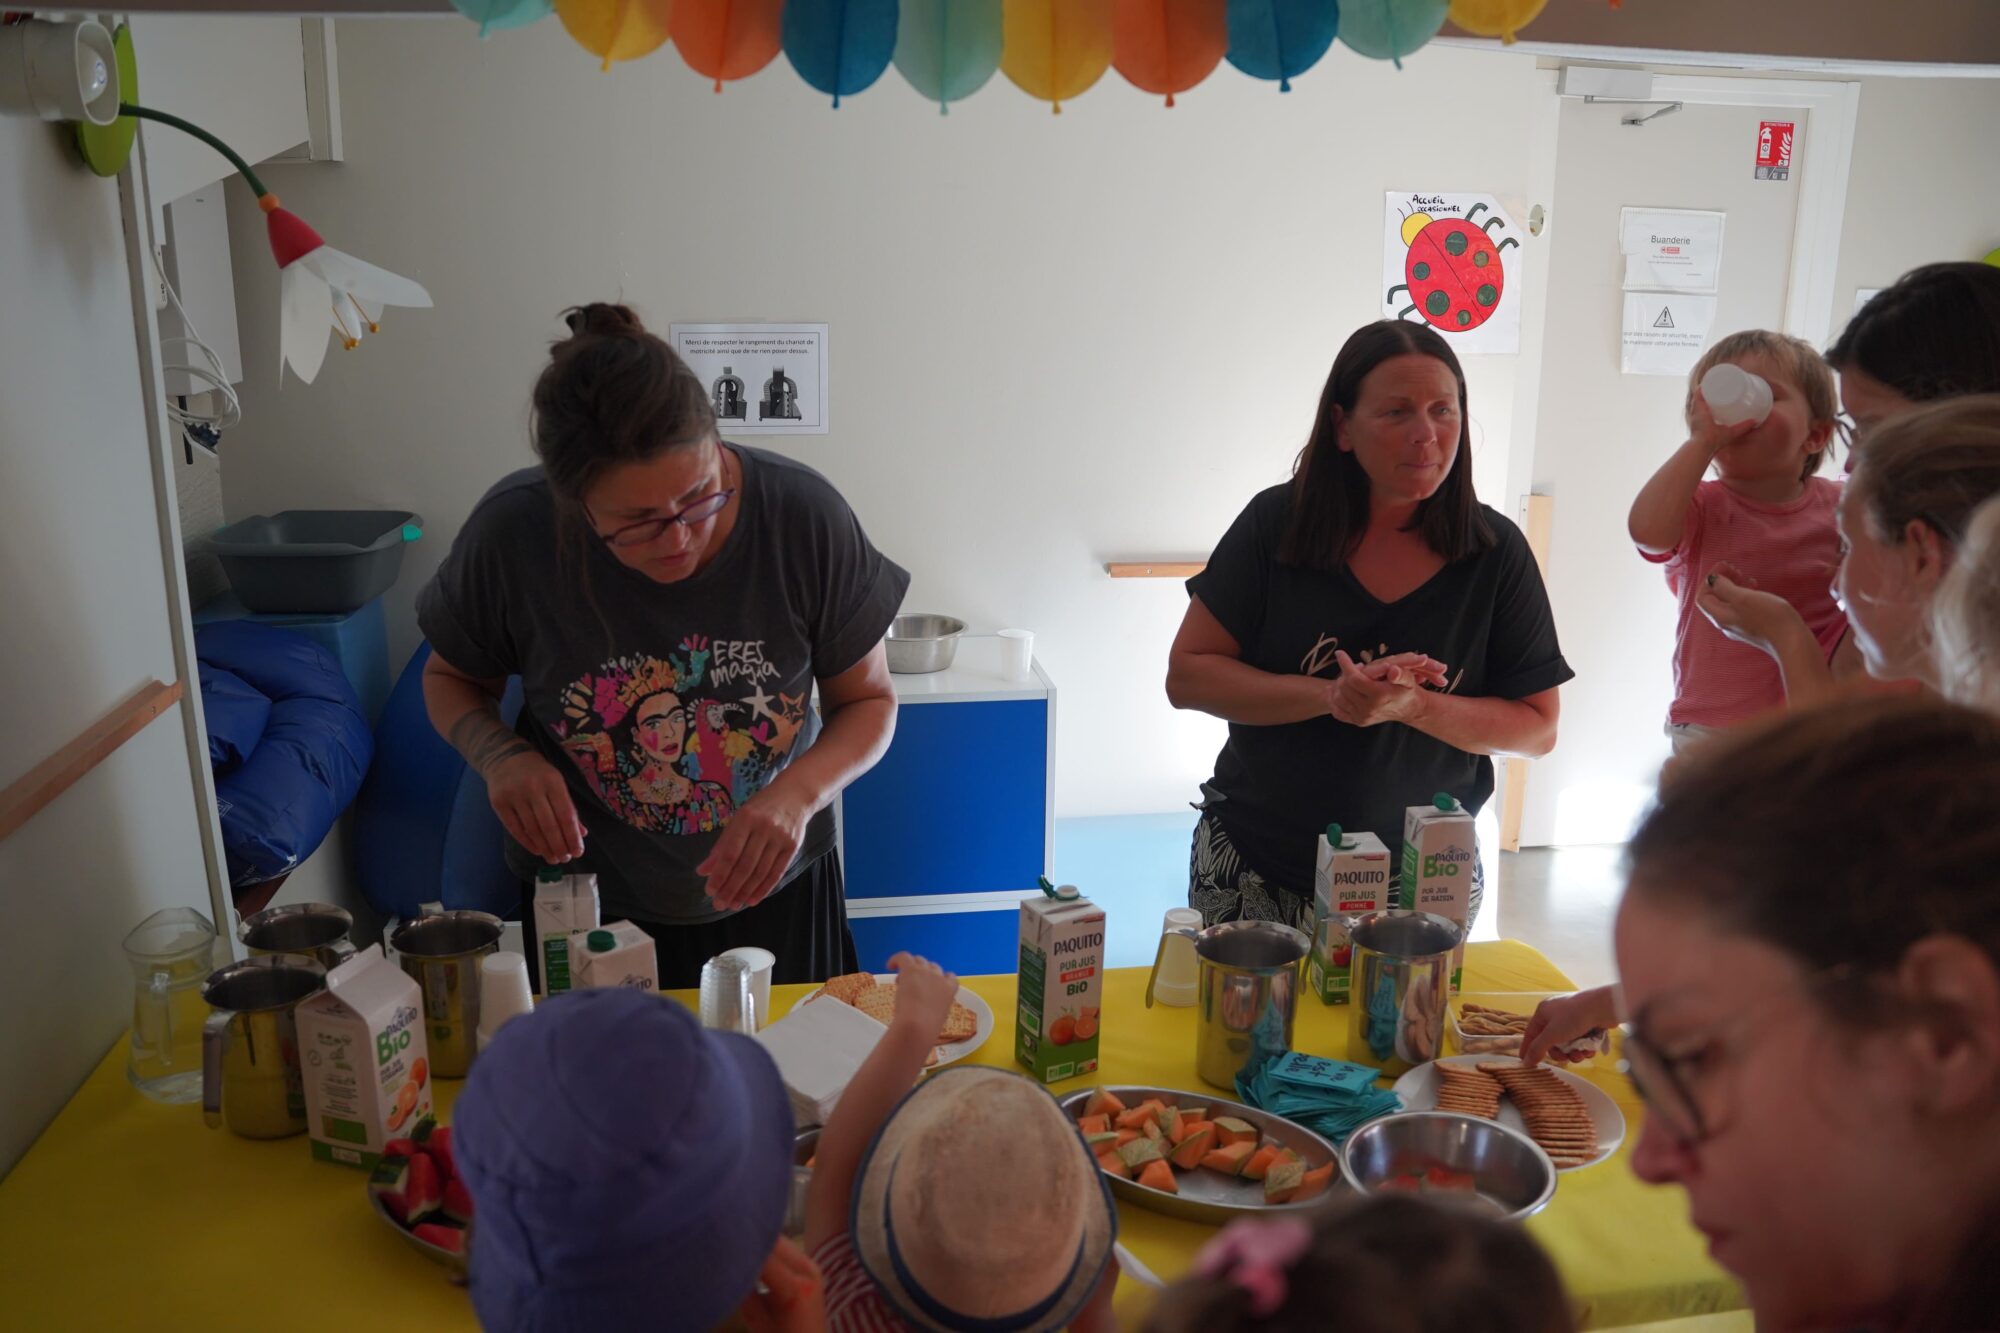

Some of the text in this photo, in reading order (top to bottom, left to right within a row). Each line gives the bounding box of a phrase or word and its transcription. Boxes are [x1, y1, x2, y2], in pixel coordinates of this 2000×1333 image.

[1650, 234, 1691, 245] Buanderie
[713, 640, 765, 666] ERES
[710, 660, 781, 687] magia
[1434, 852, 1470, 864] PAQUITO
[1334, 871, 1384, 886] PAQUITO
[1339, 890, 1376, 900] PUR JUS
[1054, 932, 1102, 956] PAQUITO
[1060, 955, 1096, 972] PUR JUS
